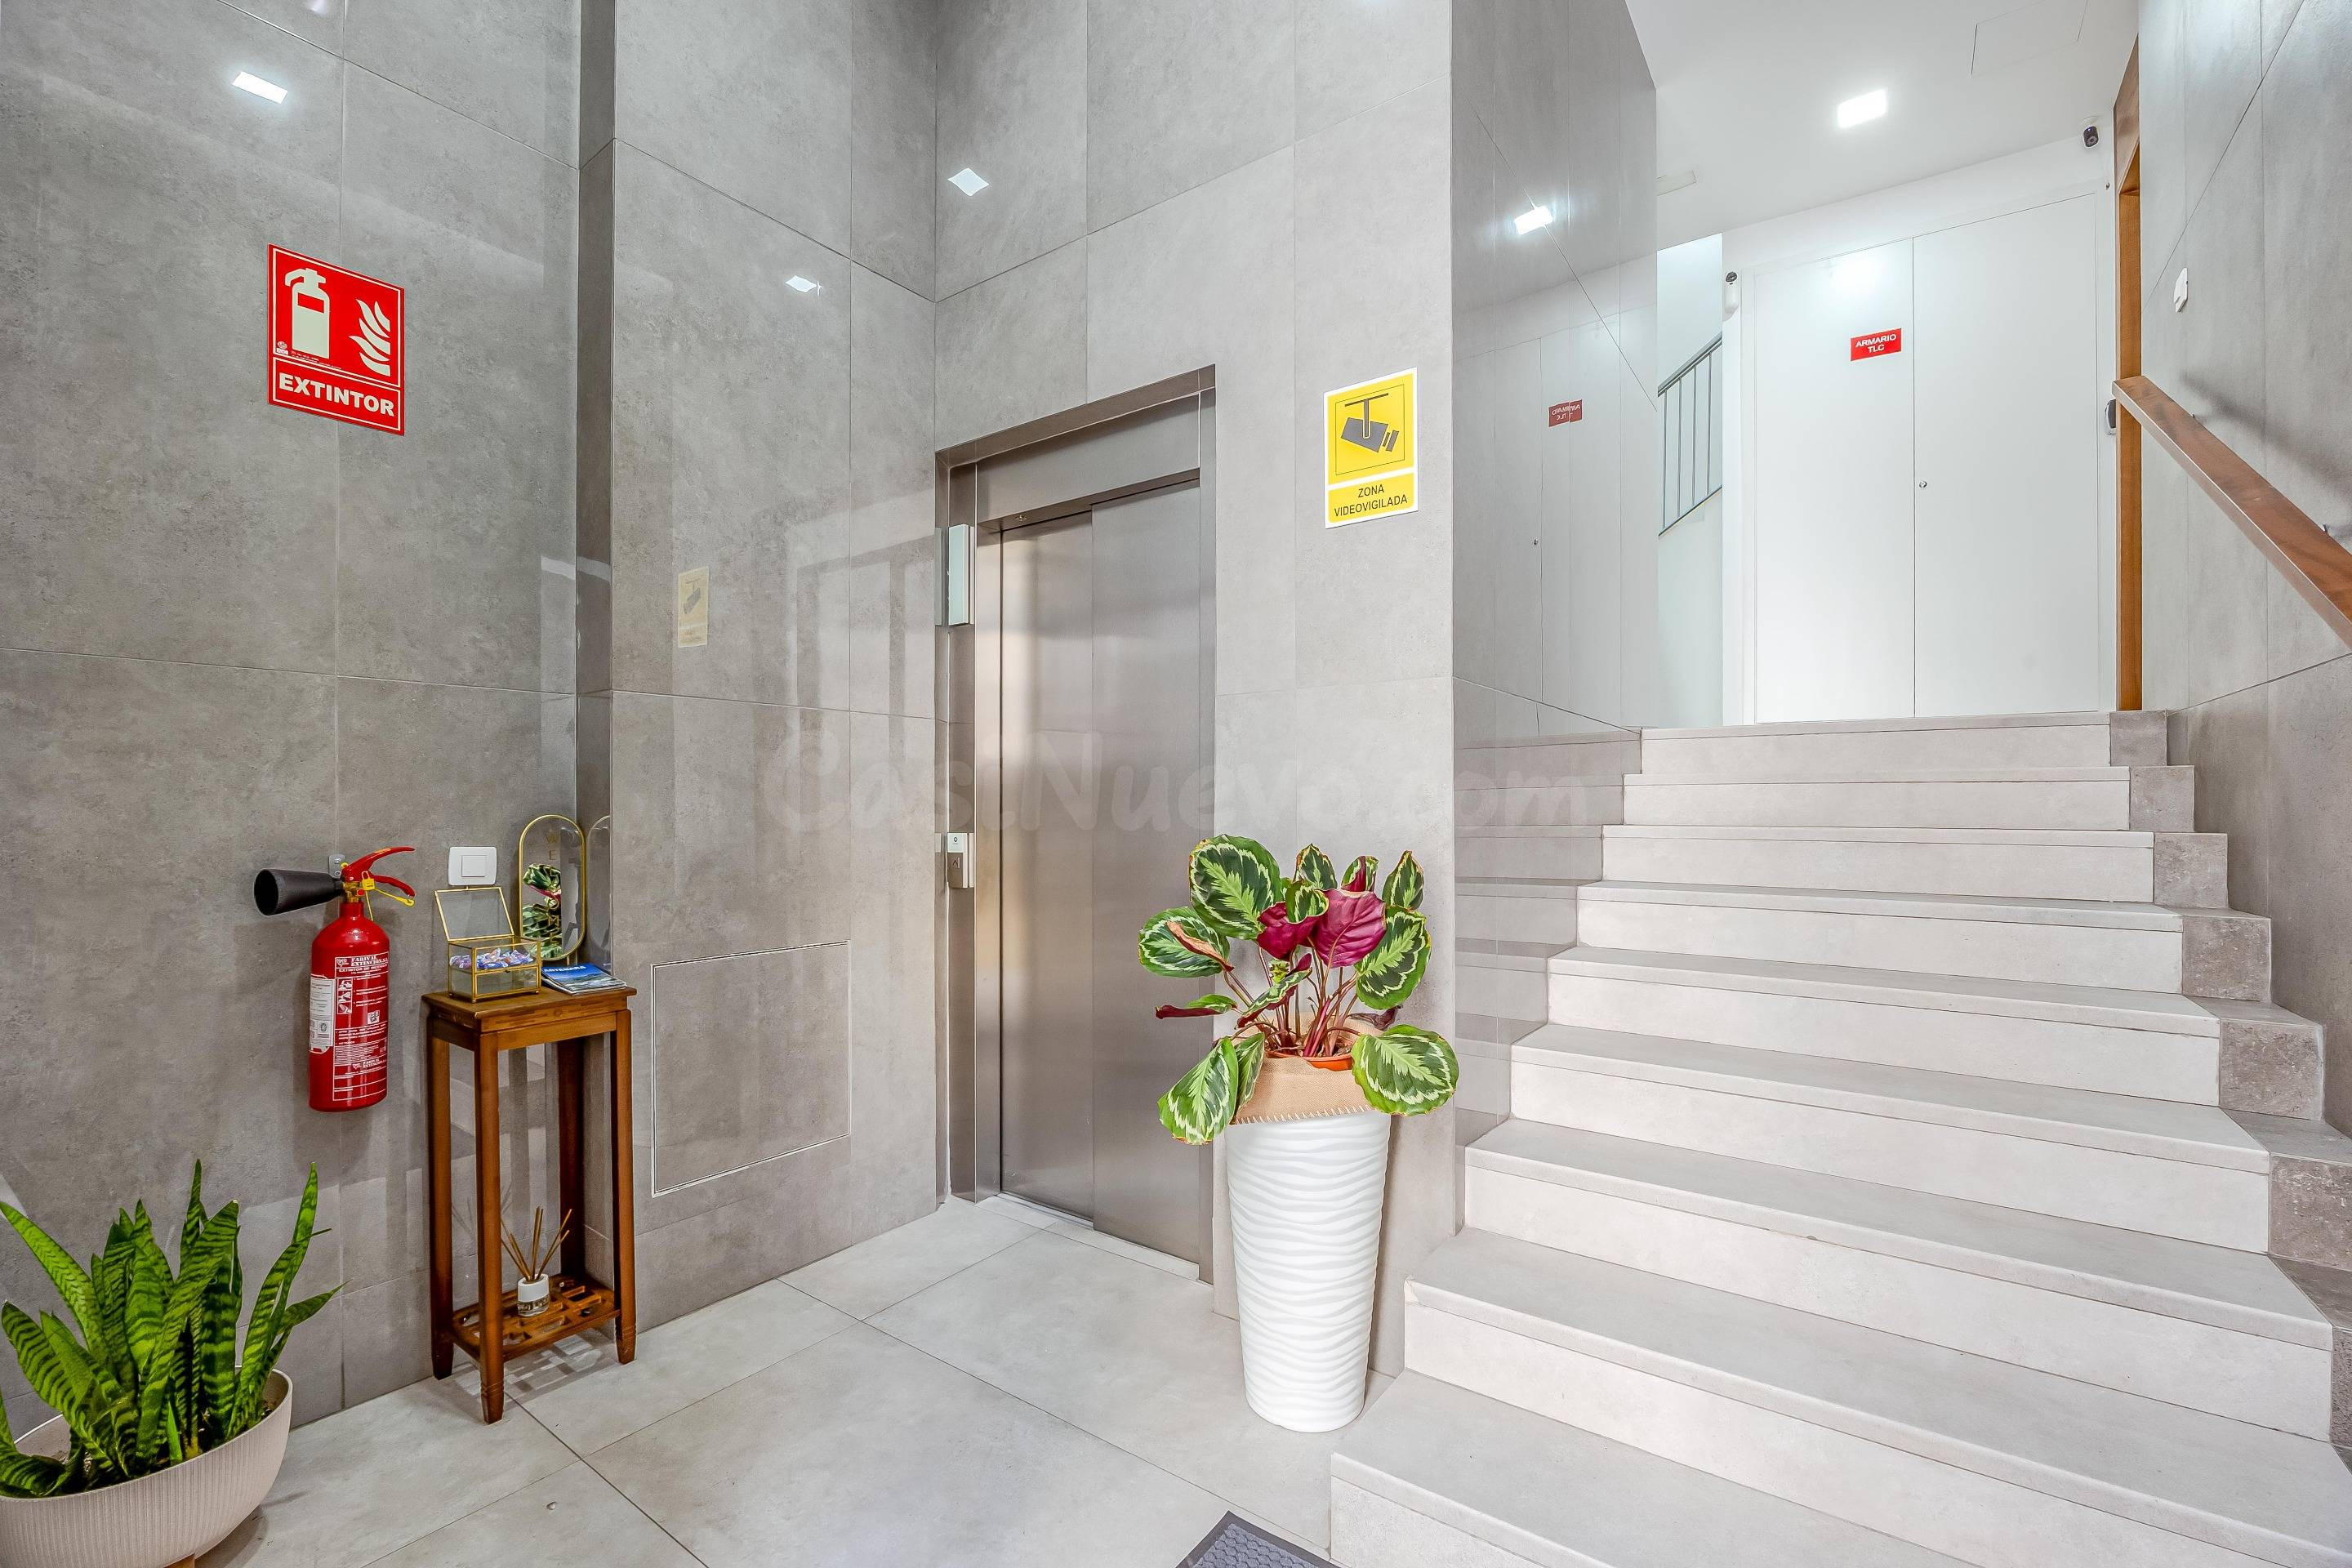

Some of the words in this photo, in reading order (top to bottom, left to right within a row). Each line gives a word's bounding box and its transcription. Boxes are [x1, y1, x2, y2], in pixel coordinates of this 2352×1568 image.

[1855, 334, 1896, 347] ARMARIO
[1868, 344, 1885, 353] TLC
[279, 372, 394, 416] EXTINTOR
[1357, 483, 1385, 498] ZONA
[1334, 494, 1408, 516] VIDEOVIGILADA
